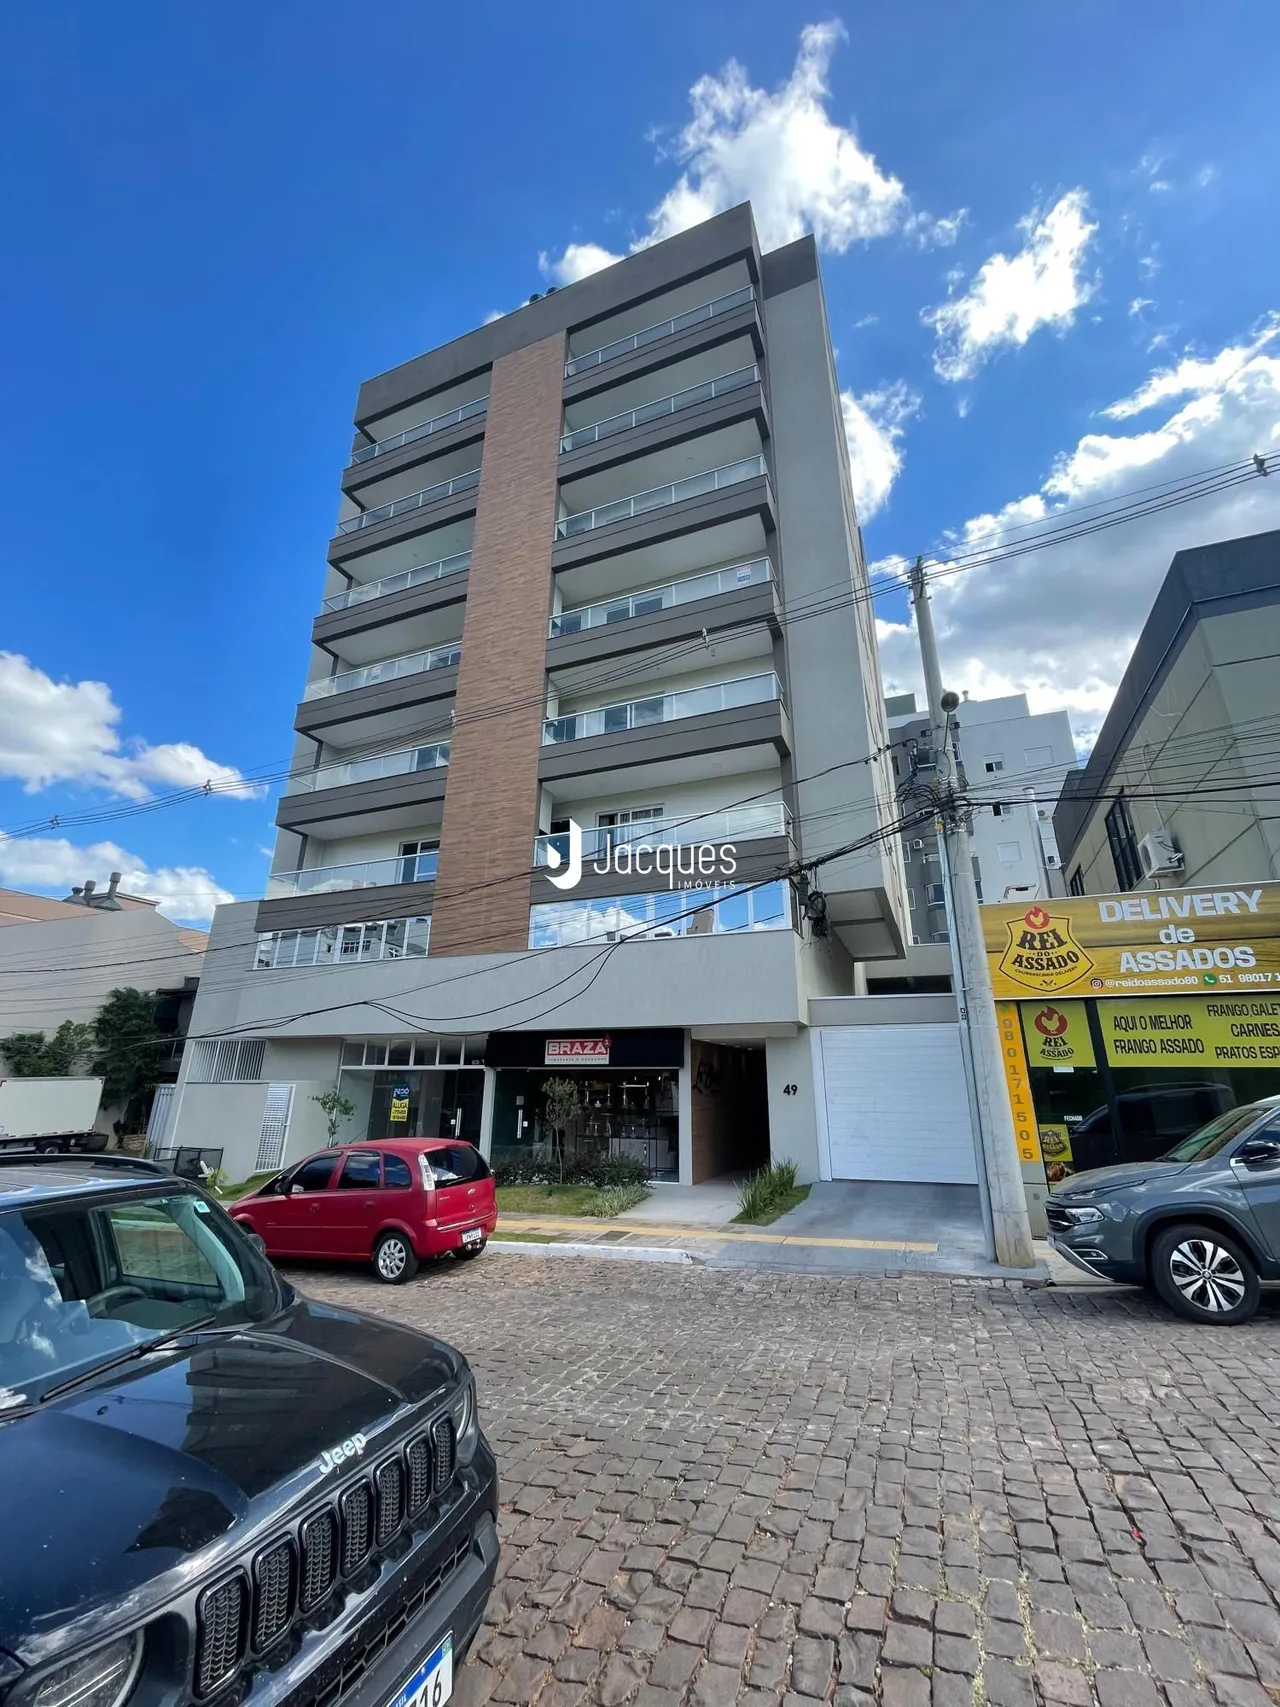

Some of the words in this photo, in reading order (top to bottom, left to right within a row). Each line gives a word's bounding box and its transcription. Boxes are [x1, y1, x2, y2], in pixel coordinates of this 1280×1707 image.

[1099, 890, 1263, 923] DELIVERY
[1016, 929, 1067, 950] REI
[1159, 925, 1196, 944] de
[1011, 951, 1079, 971] ASSADO
[1120, 947, 1257, 973] ASSADOS
[1105, 976, 1198, 988] @reidoassado80
[1219, 974, 1233, 983] 51
[1238, 973, 1272, 983] 98017
[1114, 1016, 1137, 1032] AQUI
[1140, 1016, 1147, 1030] O
[1150, 1014, 1193, 1030] MELHOR
[548, 1042, 606, 1054] BRAZA
[1042, 1036, 1068, 1047] REI
[1114, 1039, 1157, 1054] FRANGO
[1160, 1038, 1205, 1054] ASSADO
[1040, 1047, 1075, 1058] ASSADO
[1215, 1046, 1257, 1059] PRATOS
[1259, 1046, 1280, 1058] ESP
[783, 1084, 798, 1096] 49
[320, 1433, 367, 1474] Jeep
